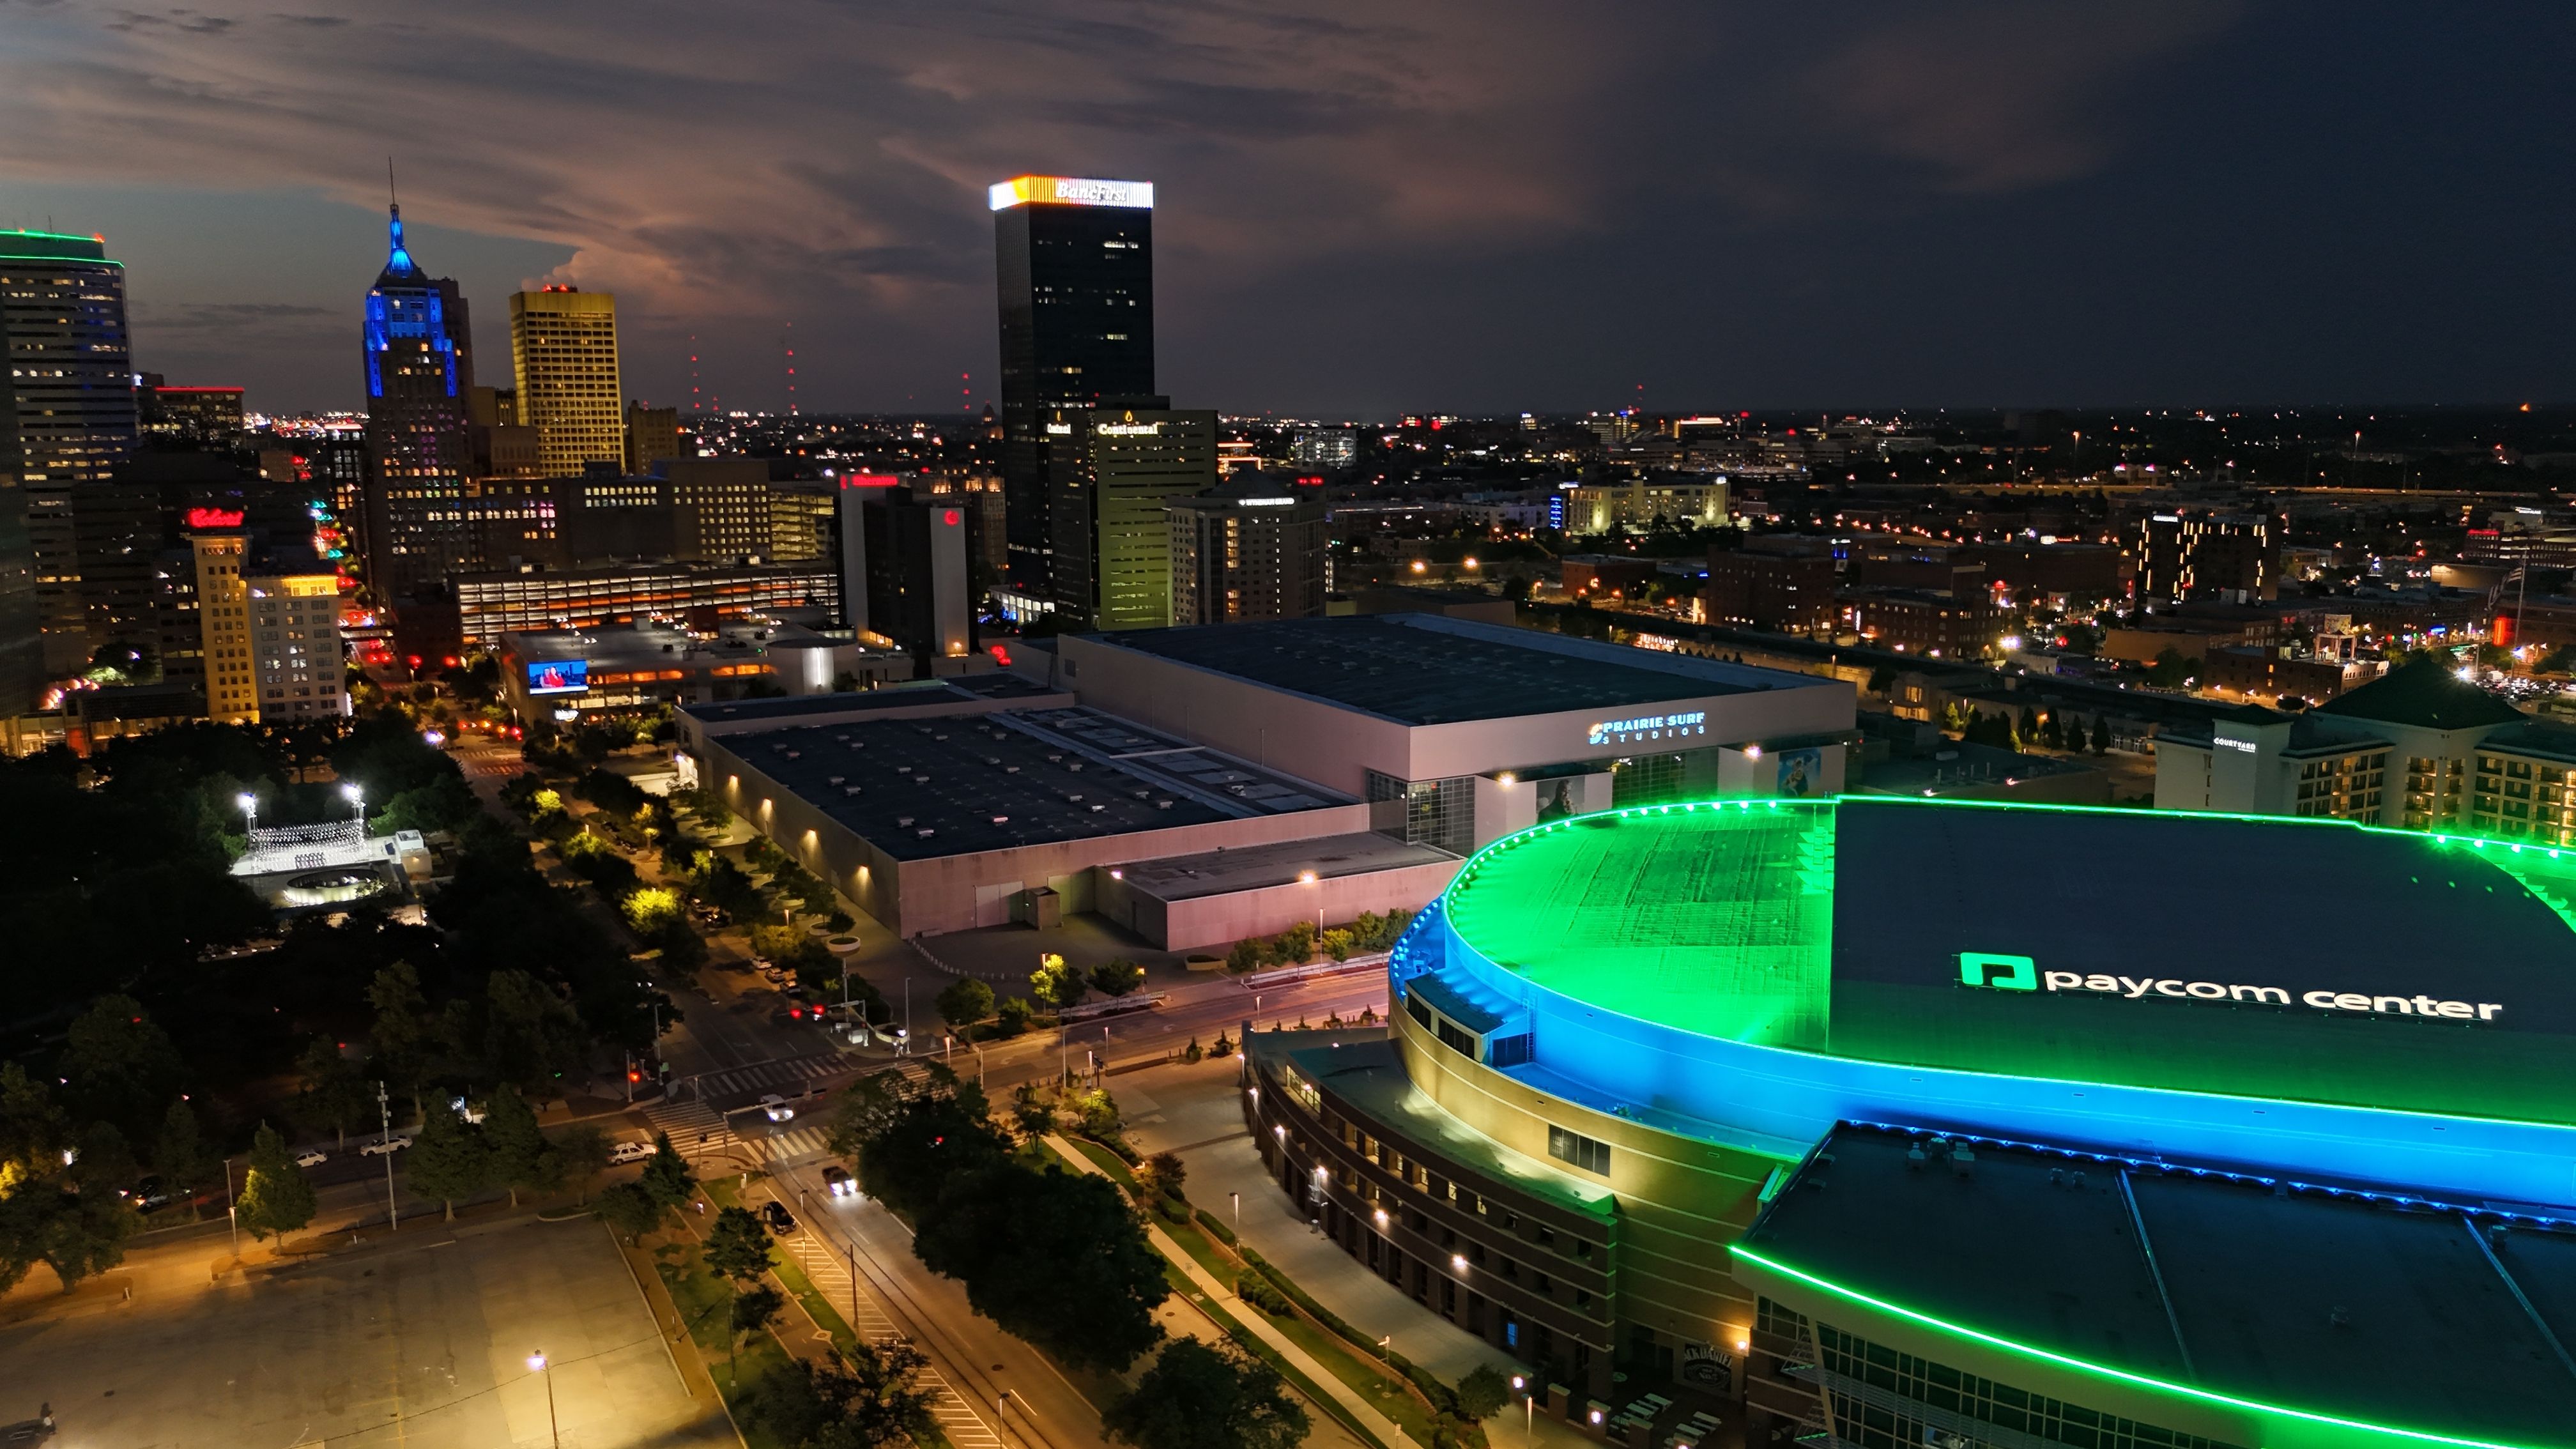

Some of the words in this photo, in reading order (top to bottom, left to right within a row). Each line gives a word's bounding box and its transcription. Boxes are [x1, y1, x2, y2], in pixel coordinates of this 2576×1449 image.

[1057, 182, 1126, 201] BancFirst
[1098, 423, 1158, 435] Continental
[1603, 717, 1664, 733] PRAIRIE
[1667, 712, 1705, 726] SURF
[2213, 737, 2256, 750] COURTYARD
[2044, 970, 2292, 1004] paycom
[2303, 990, 2503, 1021] center
